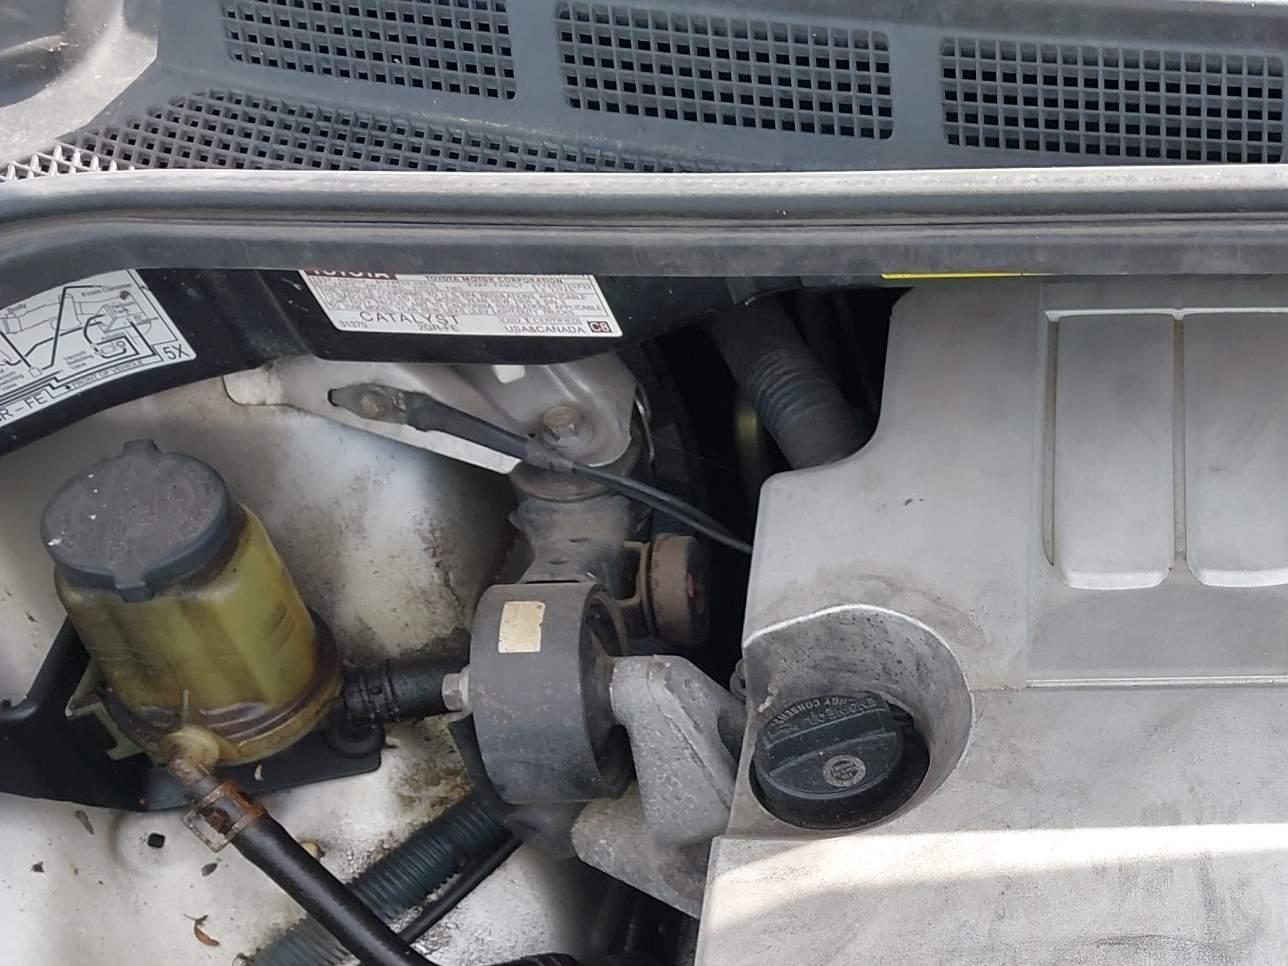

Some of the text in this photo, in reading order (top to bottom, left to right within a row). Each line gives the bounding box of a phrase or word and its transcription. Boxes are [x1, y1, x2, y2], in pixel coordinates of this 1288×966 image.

[359, 311, 459, 325] CATALYST
[504, 324, 586, 333] USA&CANADA
[589, 322, 611, 332] CB
[162, 343, 190, 360] 5X
